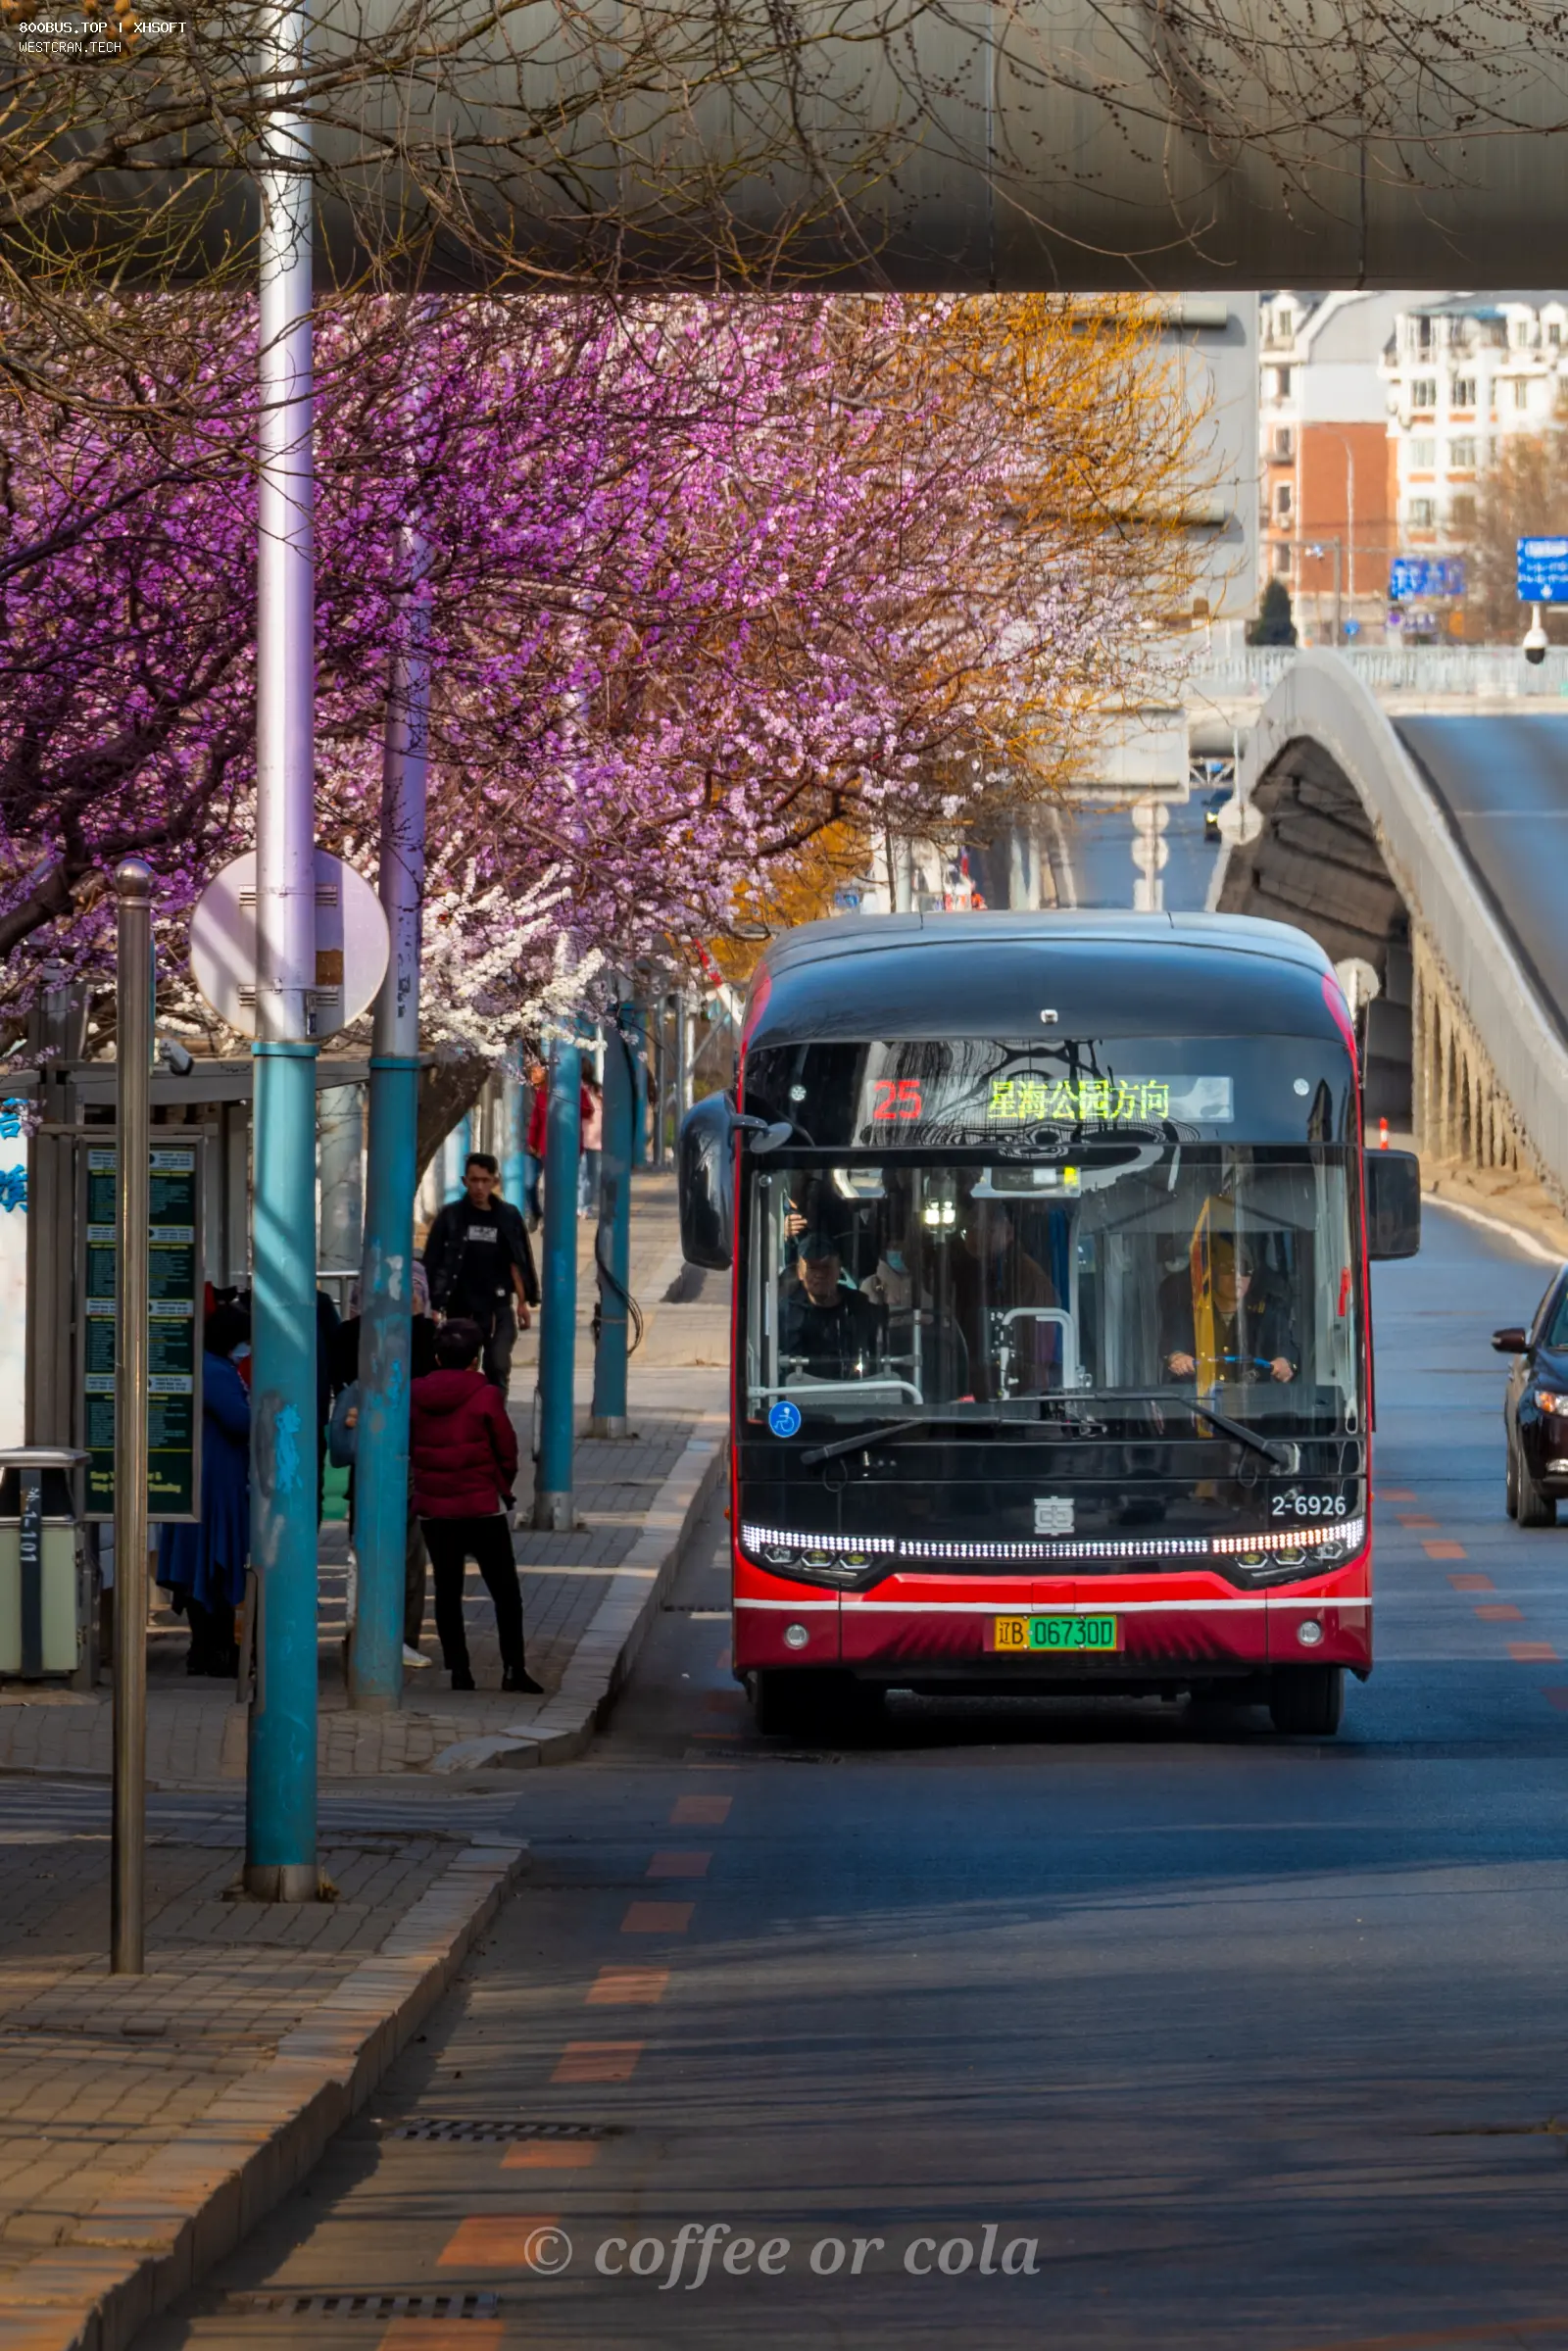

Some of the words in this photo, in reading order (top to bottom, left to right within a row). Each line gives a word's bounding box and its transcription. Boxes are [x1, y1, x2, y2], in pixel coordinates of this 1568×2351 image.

[873, 1080, 922, 1120] 25
[987, 1079, 1169, 1120] 星海公园方向
[1271, 1495, 1347, 1516] 2-6926
